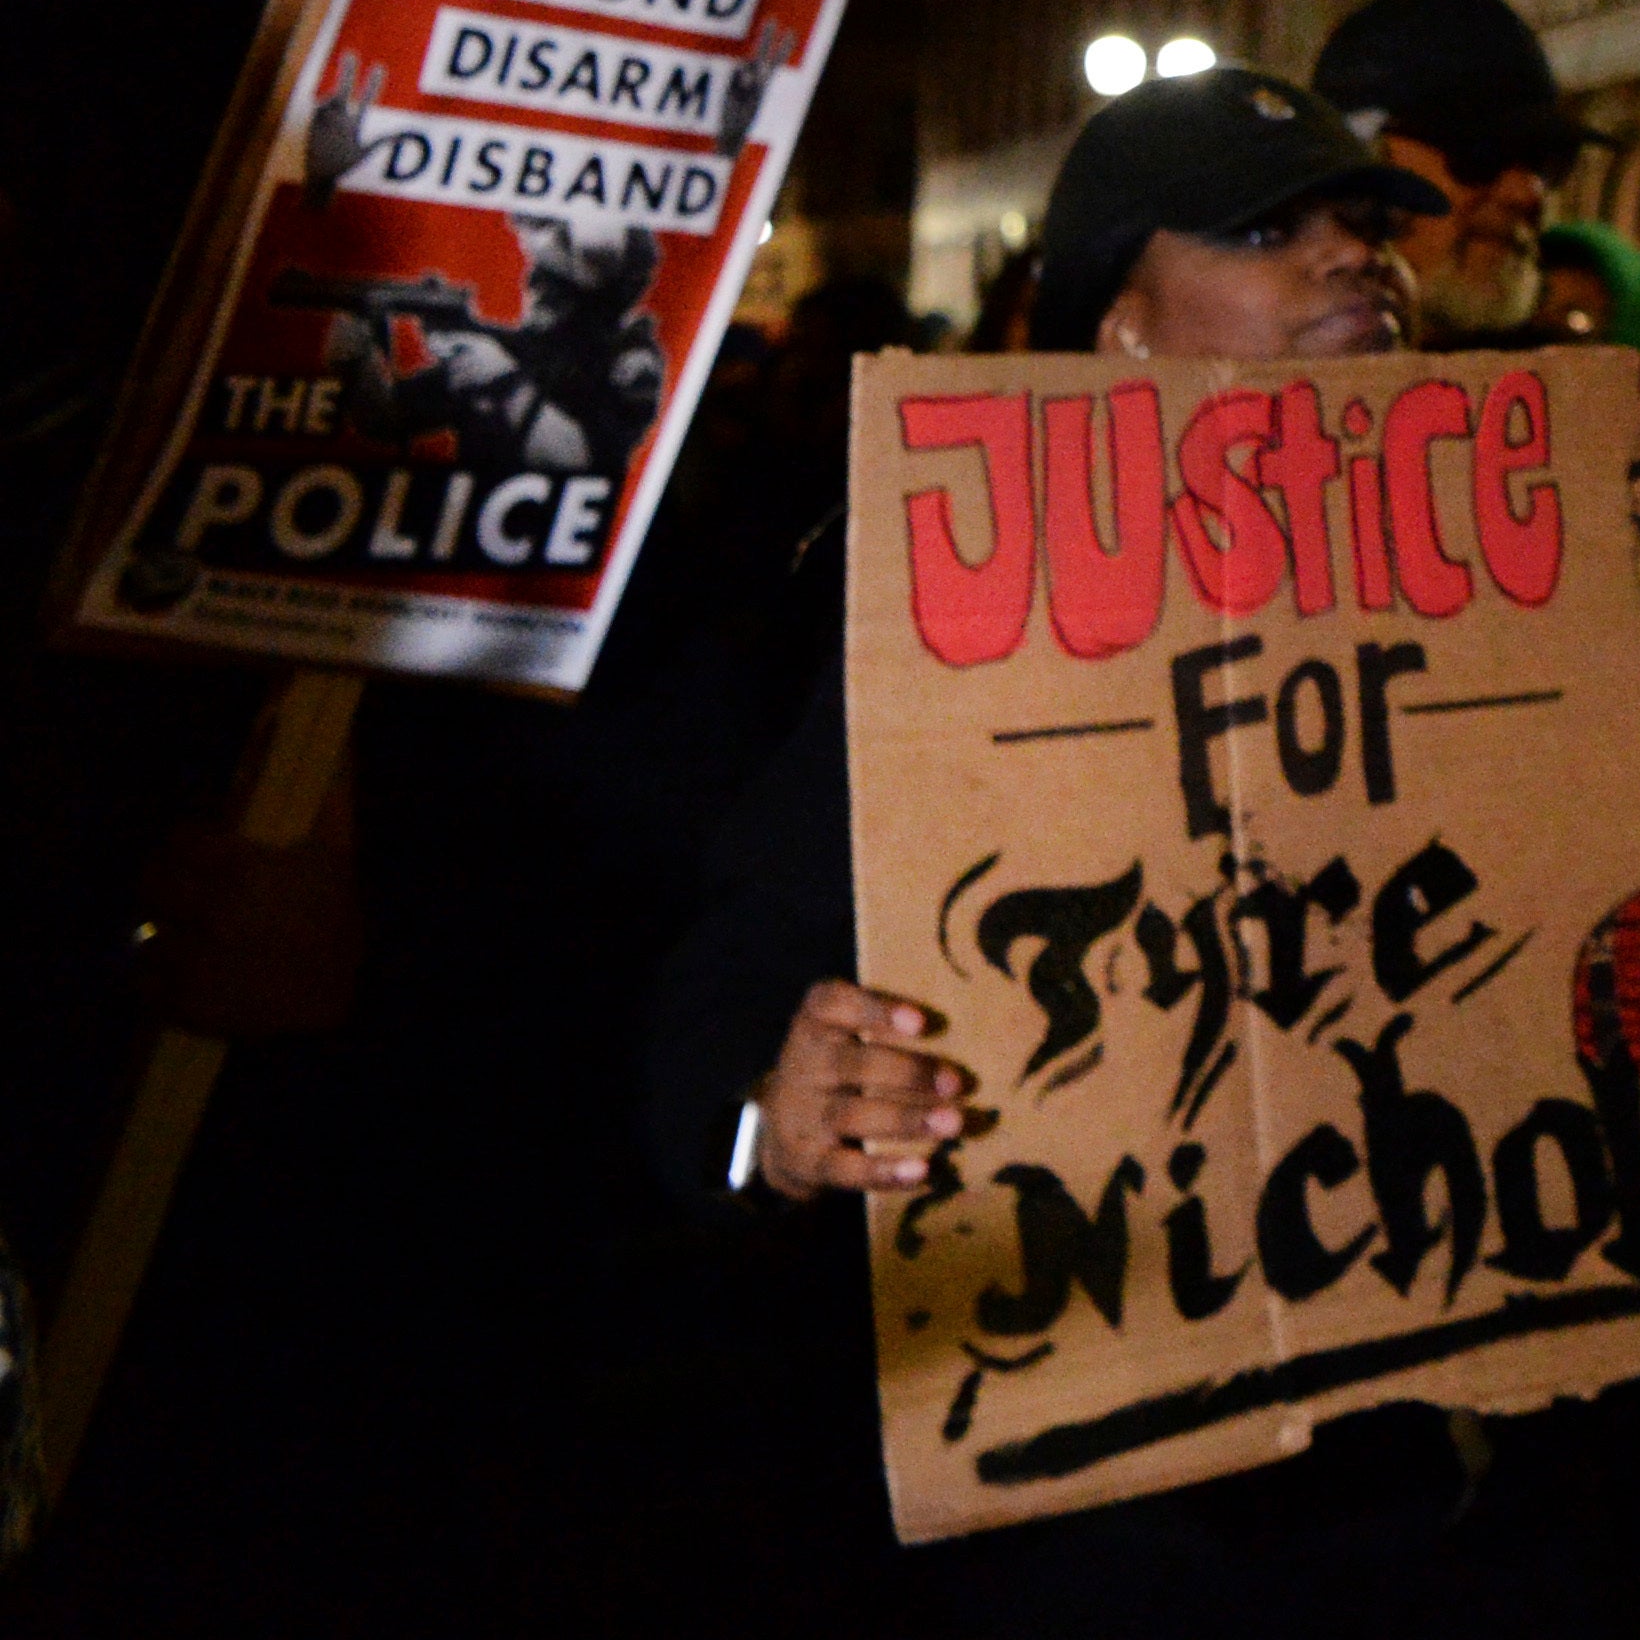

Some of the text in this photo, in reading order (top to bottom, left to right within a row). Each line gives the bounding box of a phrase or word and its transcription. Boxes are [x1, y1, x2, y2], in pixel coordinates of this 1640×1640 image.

[447, 27, 711, 119] DISARM
[384, 131, 717, 216] DISBAND
[221, 375, 345, 436] THE
[173, 461, 613, 568] POLICE
[977, 836, 1497, 1125] Tyre
